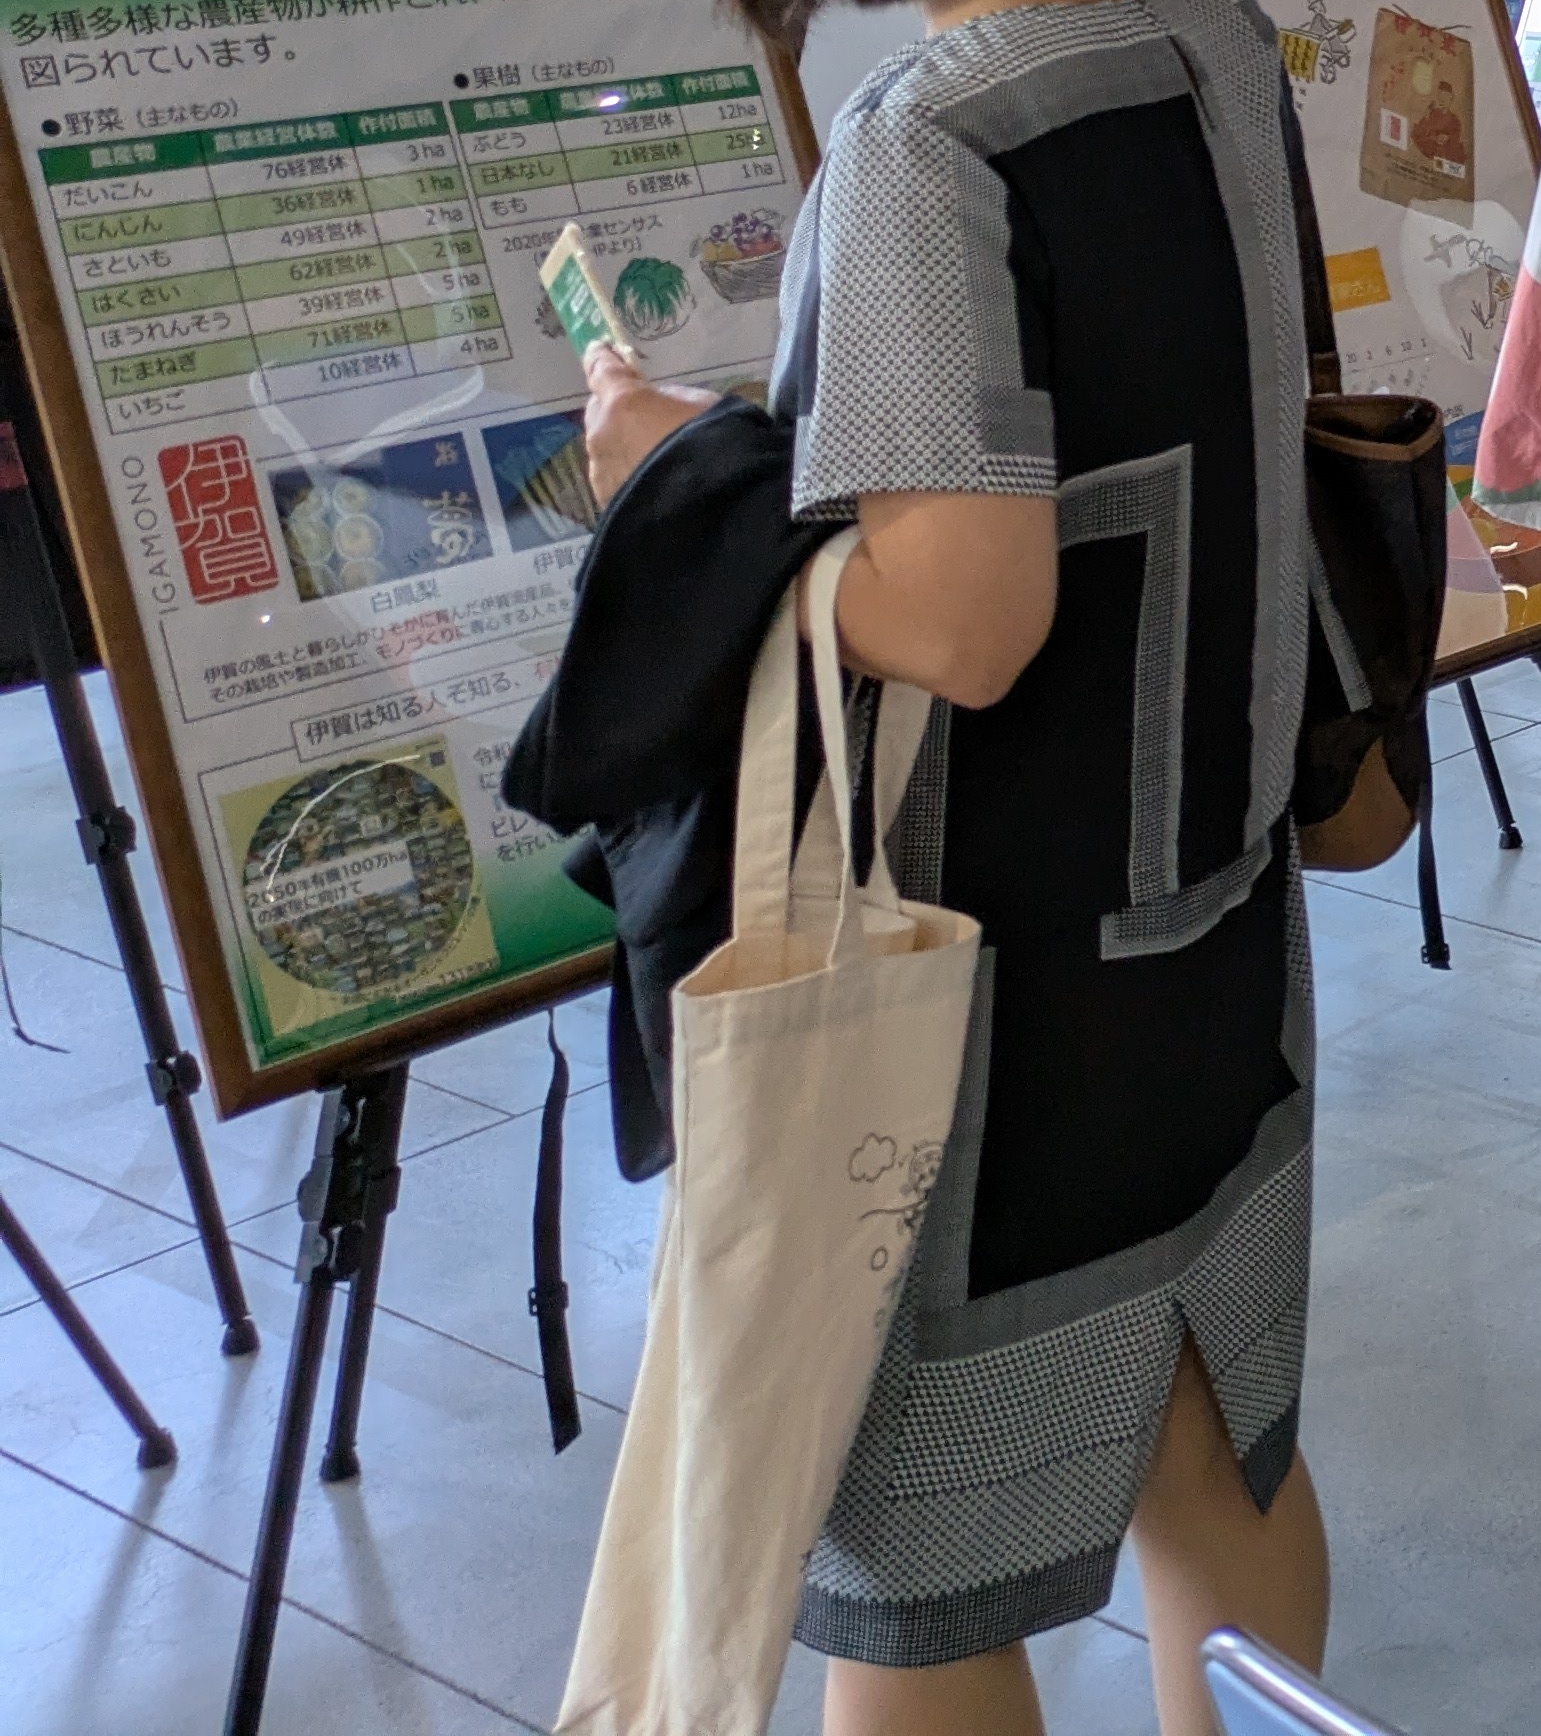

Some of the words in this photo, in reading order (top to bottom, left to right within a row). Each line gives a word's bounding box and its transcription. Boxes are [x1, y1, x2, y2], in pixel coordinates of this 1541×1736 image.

[20, 34, 296, 88] 図られています。
[121, 455, 179, 613] IGAMONO
[160, 437, 279, 603] 伊賀
